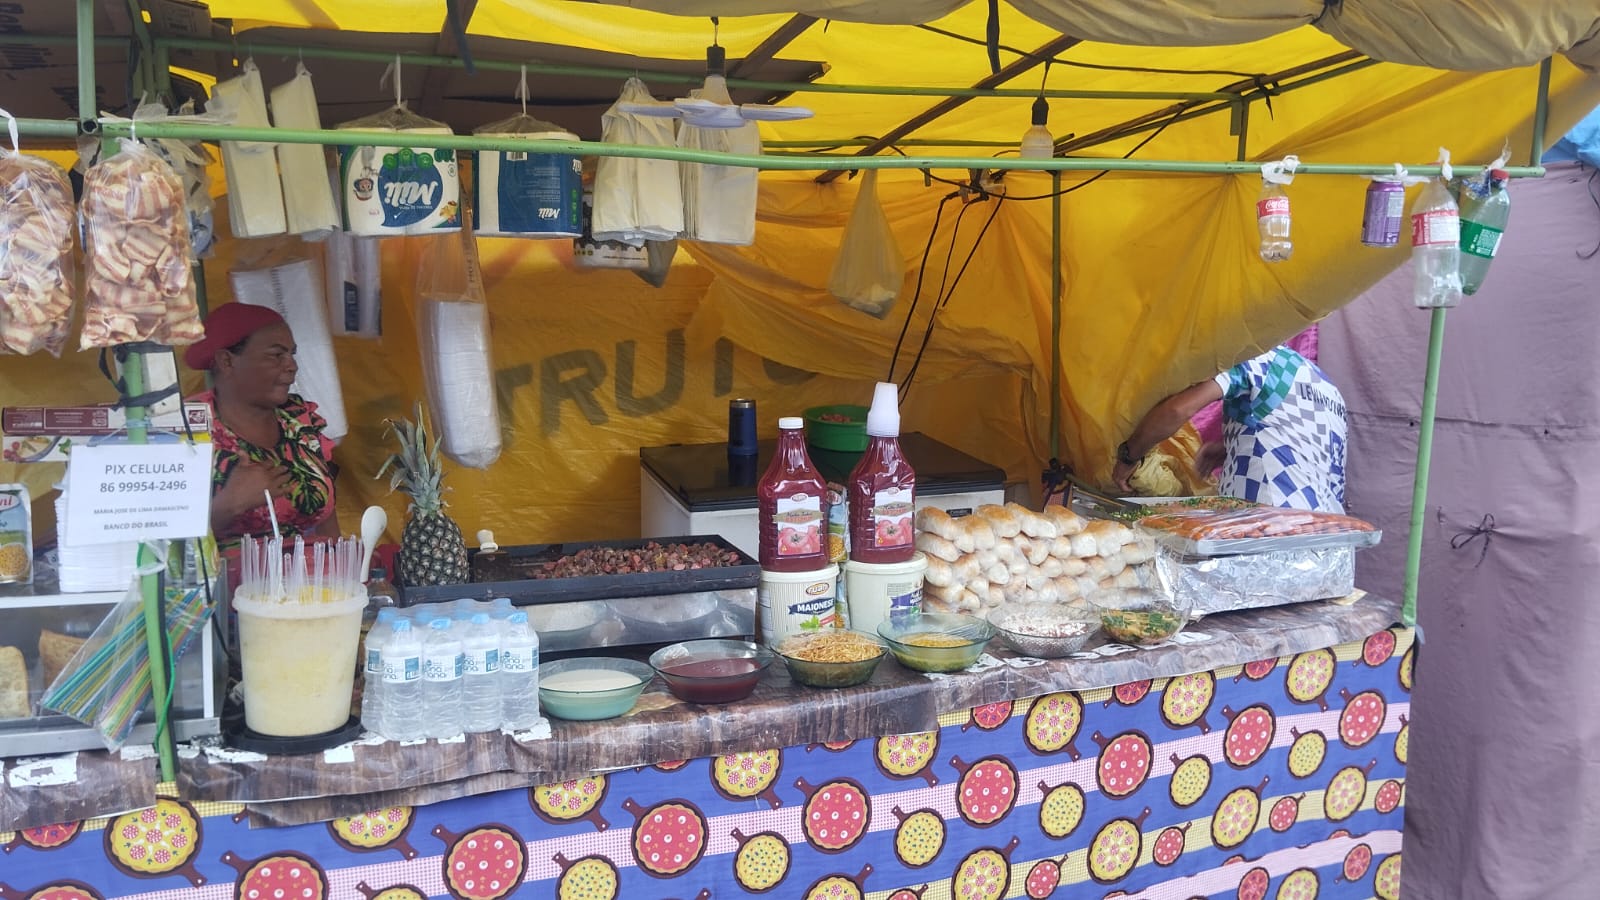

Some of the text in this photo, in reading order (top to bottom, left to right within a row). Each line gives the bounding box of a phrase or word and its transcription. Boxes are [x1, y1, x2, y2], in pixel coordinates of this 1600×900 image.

[384, 180, 439, 207] Mili
[538, 207, 560, 219] Mili
[105, 463, 185, 475] PIX CELULAR
[100, 480, 187, 493] 86 99954-2496
[797, 599, 834, 612] MAIONESE
